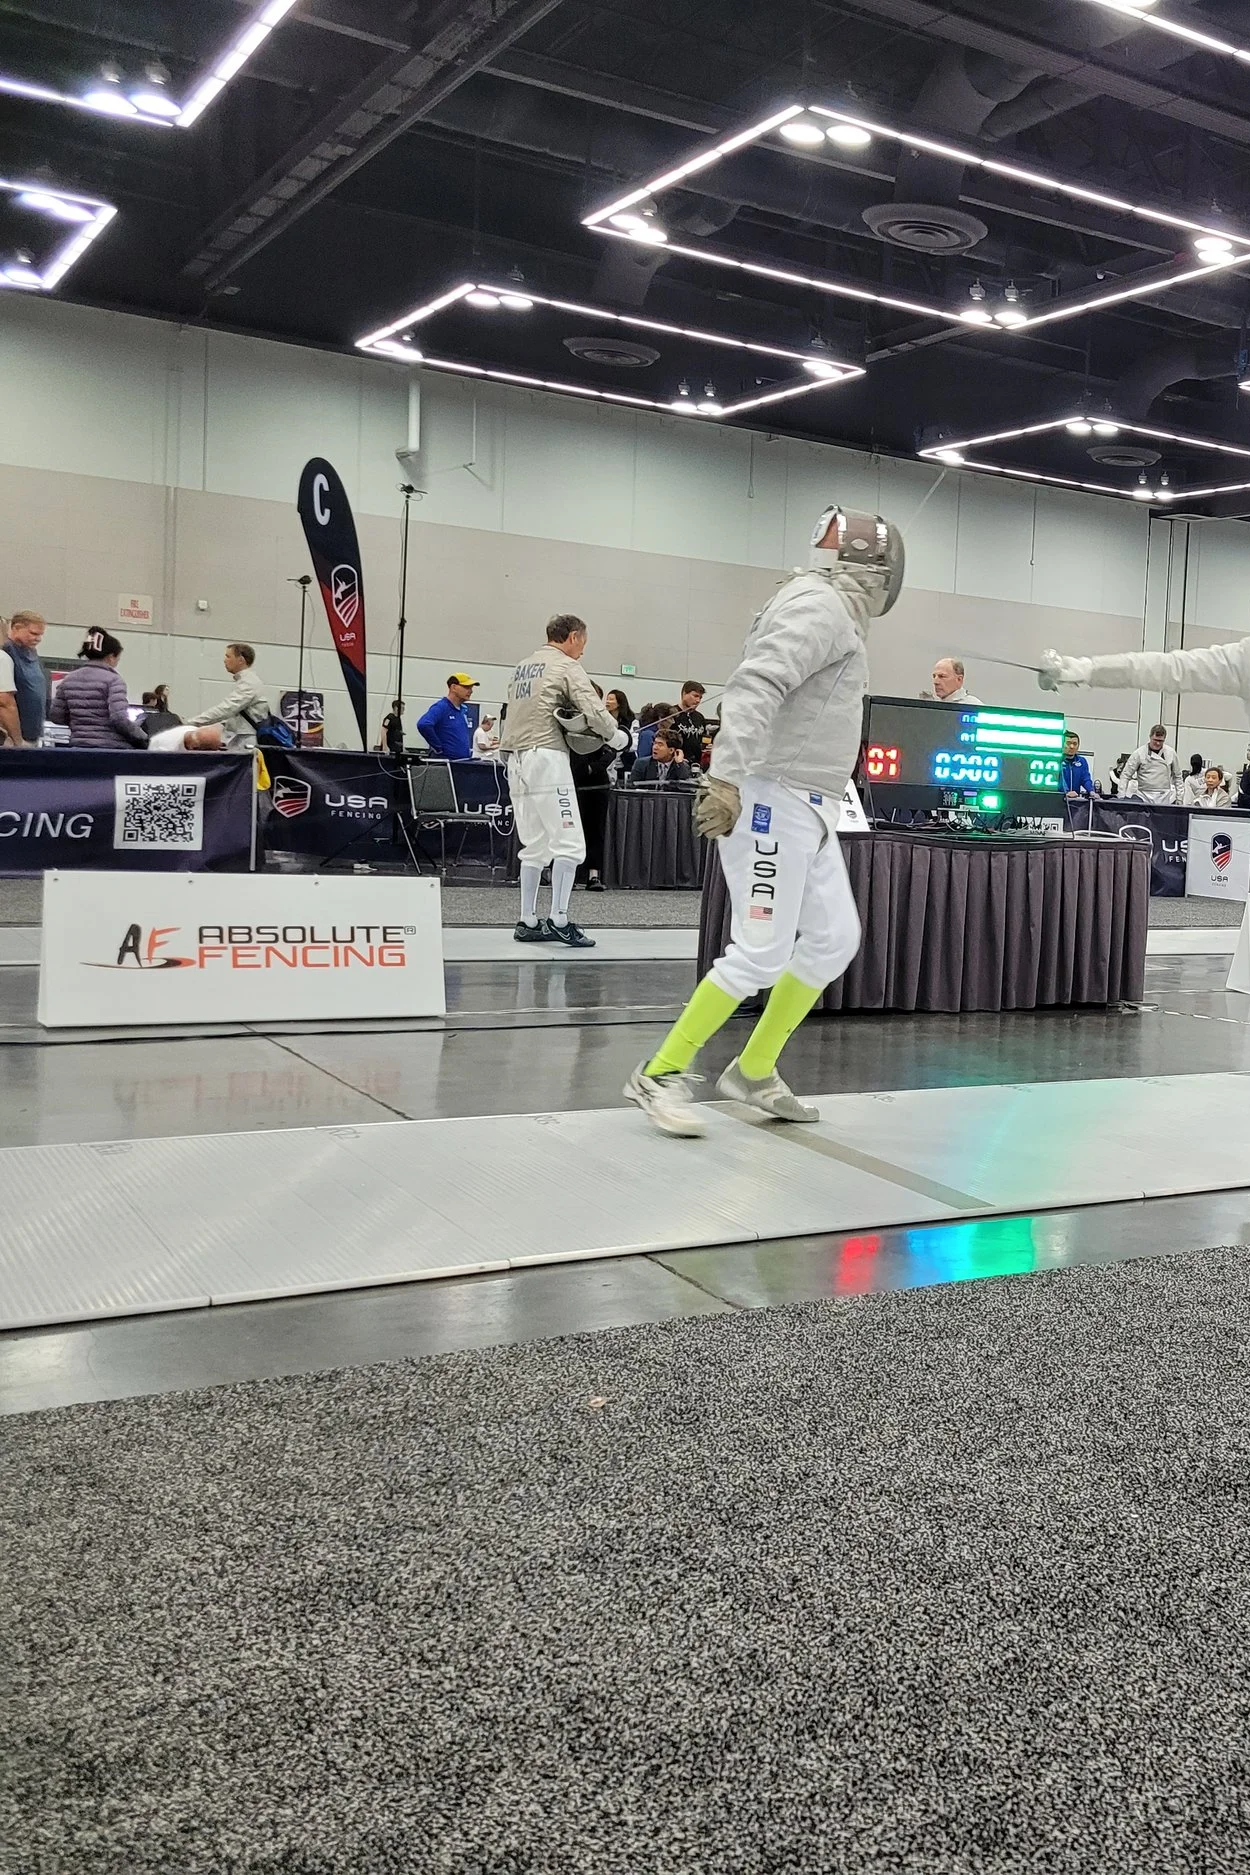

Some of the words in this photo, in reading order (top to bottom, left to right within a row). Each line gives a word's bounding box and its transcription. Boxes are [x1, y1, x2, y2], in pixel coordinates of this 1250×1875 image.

[313, 473, 331, 526] C
[339, 632, 356, 642] USA
[514, 663, 545, 682] BAKER
[515, 682, 532, 700] USA
[867, 747, 898, 777] 01
[1029, 759, 1060, 786] 02
[324, 793, 389, 809] USA
[557, 787, 573, 819] USA
[330, 809, 382, 820] FENCING
[750, 839, 779, 900] USA
[1210, 875, 1229, 883] USA
[198, 945, 407, 969] FENCING
